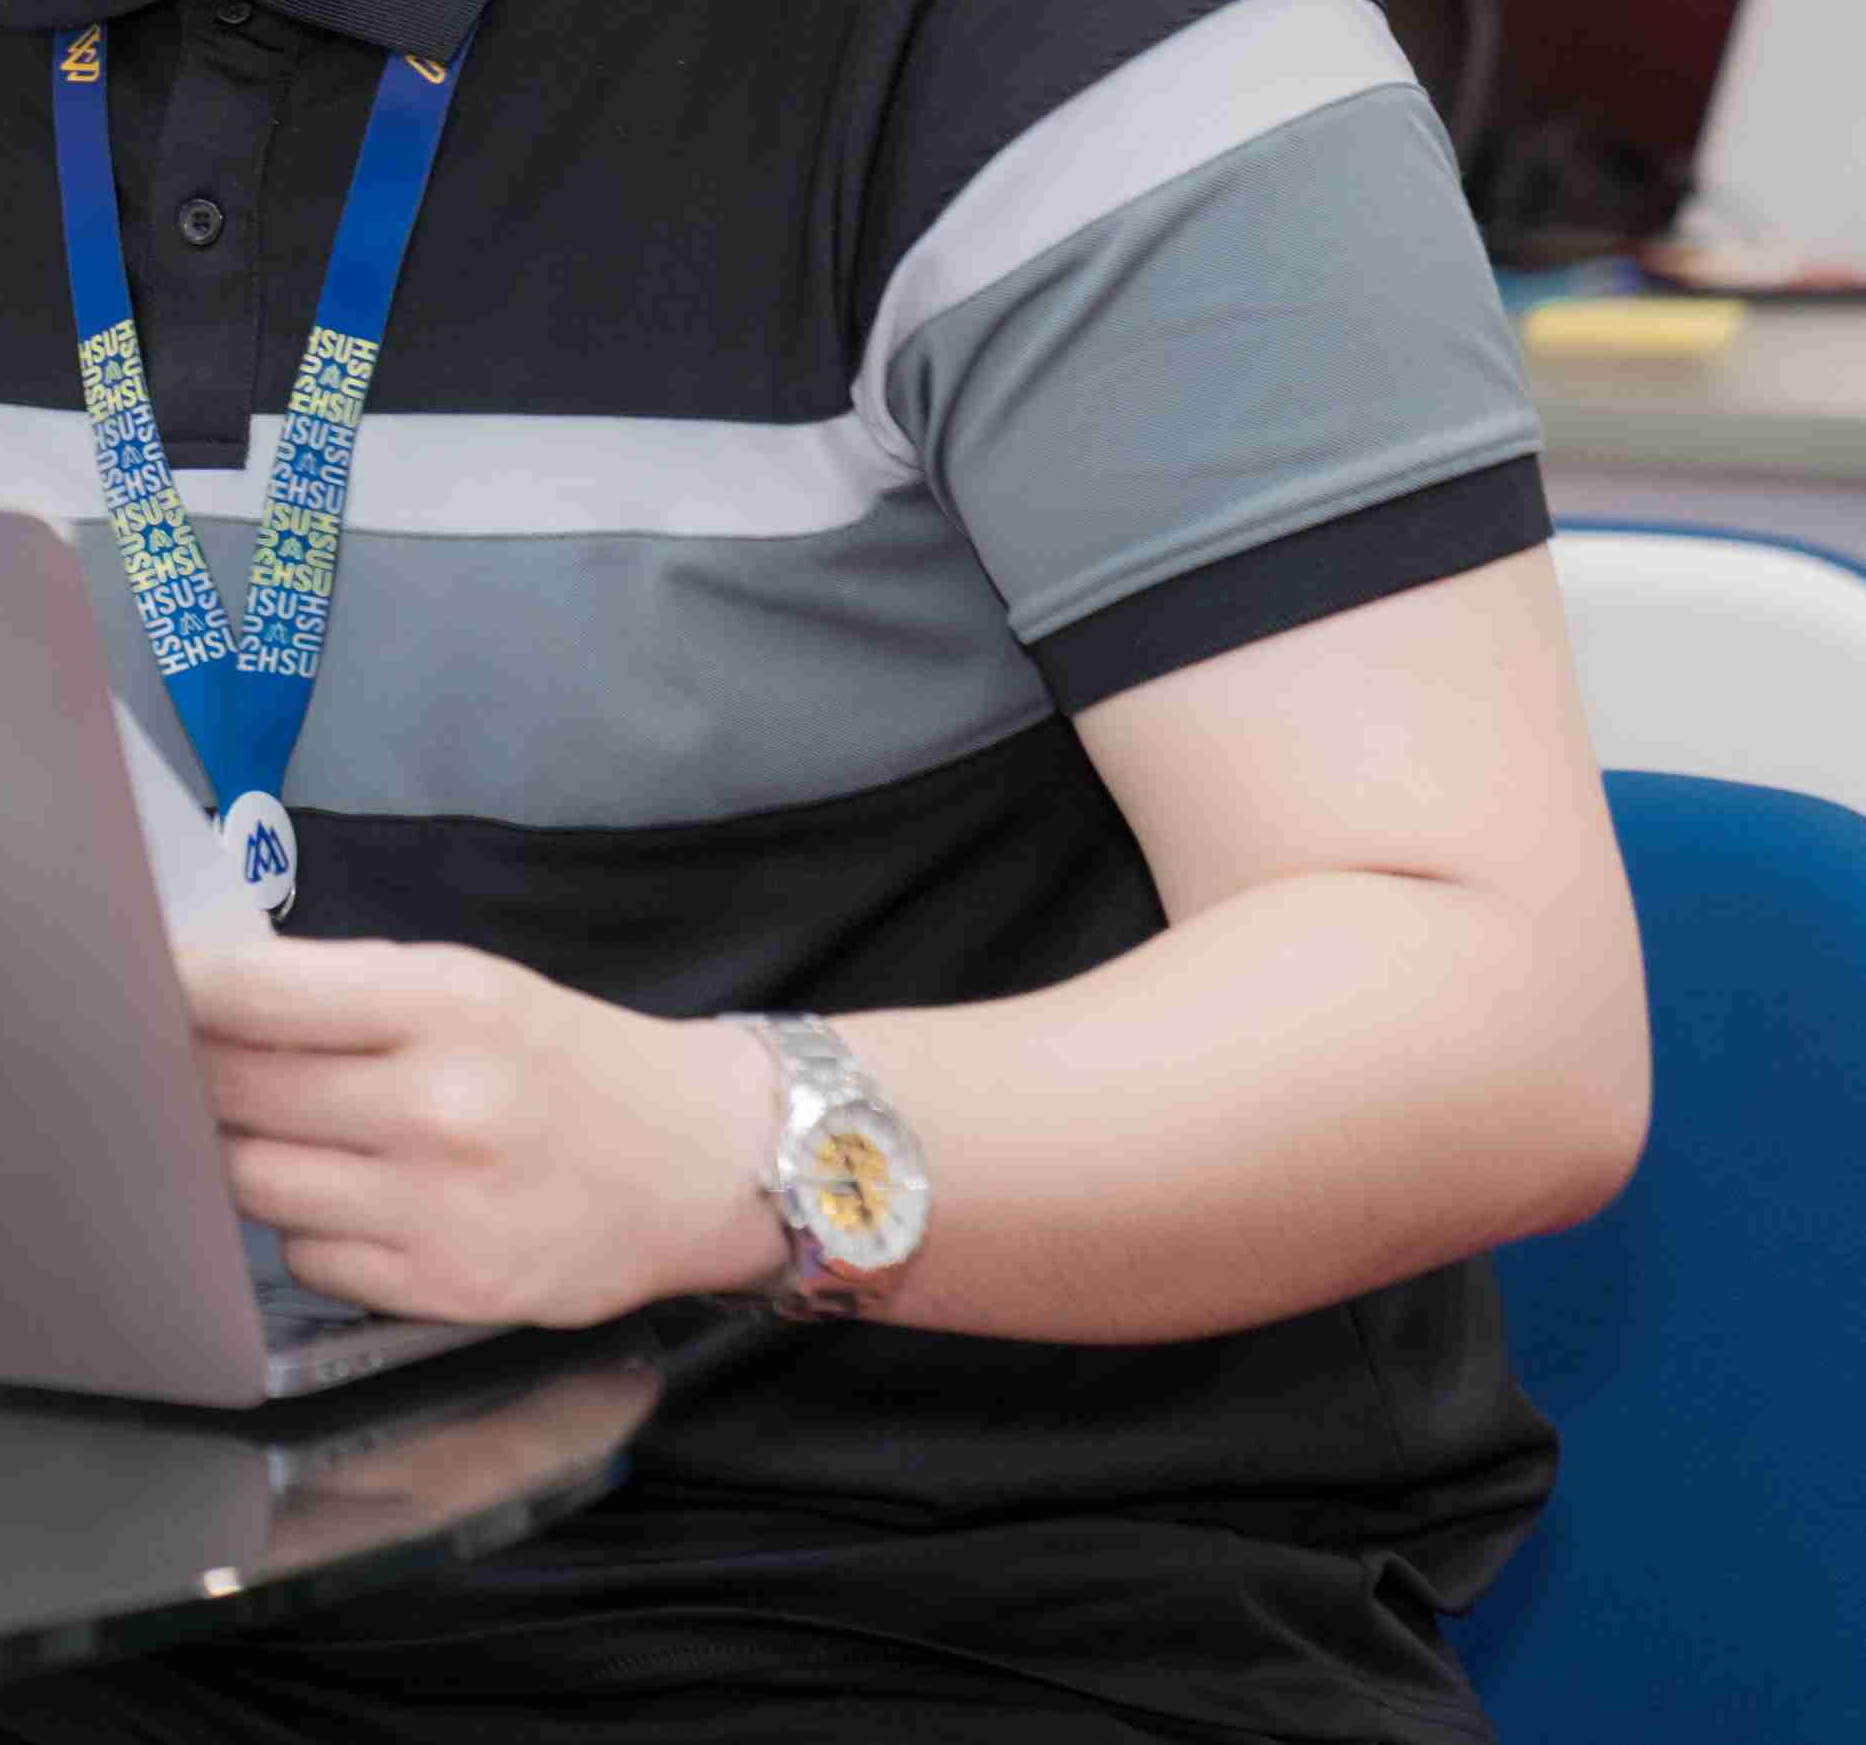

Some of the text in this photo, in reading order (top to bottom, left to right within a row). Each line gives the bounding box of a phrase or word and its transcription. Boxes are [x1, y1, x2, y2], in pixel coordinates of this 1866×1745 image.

[341, 336, 380, 399] HSU
[309, 388, 364, 428] HSU
[320, 424, 354, 487] HSU
[287, 473, 346, 515] HSU
[306, 511, 341, 570] HSU
[135, 579, 196, 621] HSU
[272, 558, 332, 597] HSU
[144, 617, 190, 675] HSU
[292, 594, 329, 652] HSU
[259, 647, 317, 678] HSU
